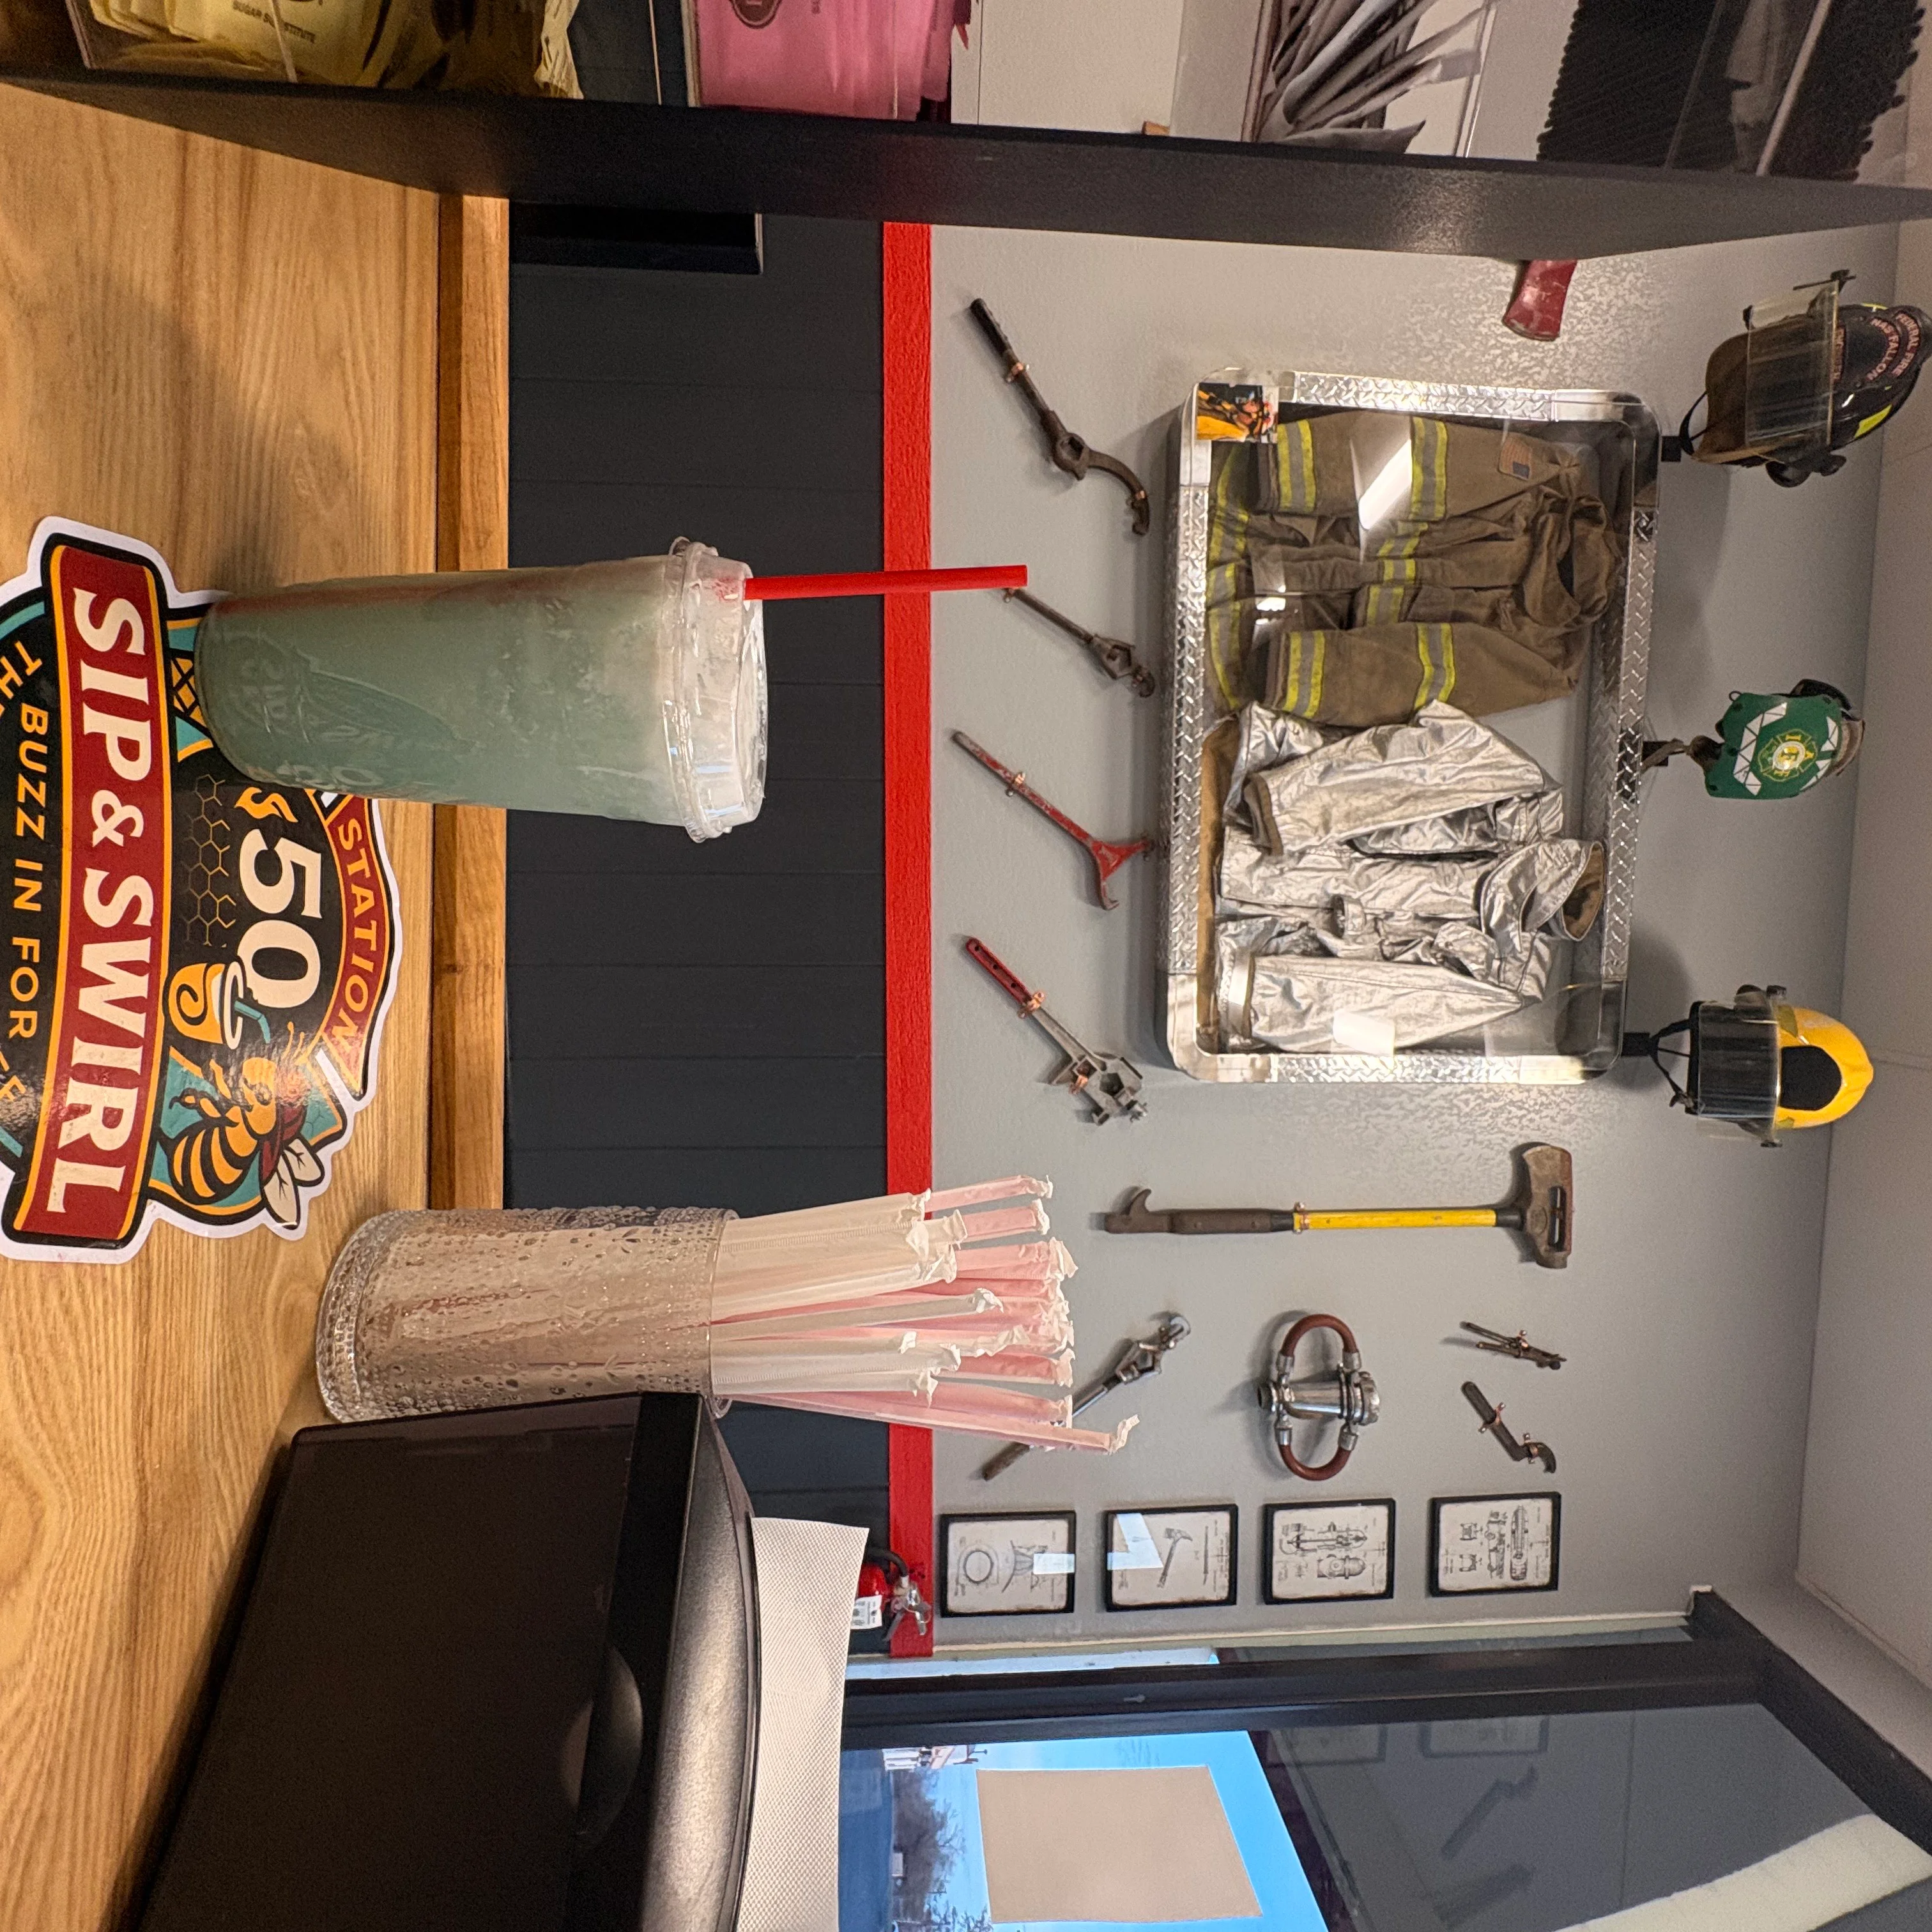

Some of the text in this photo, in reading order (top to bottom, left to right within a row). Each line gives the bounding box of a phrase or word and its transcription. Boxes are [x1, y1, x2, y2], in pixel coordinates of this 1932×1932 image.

[1866, 318, 1899, 381] NAS FALLON
[1892, 313, 1919, 377] FEDERAL FIRE
[17, 703, 49, 839] BUZZ
[14, 859, 43, 911] IN
[48, 589, 153, 1212] SIP & SWIRL
[237, 829, 322, 1008] 50
[330, 818, 376, 1051] STATION
[9, 937, 40, 1038] FOR
